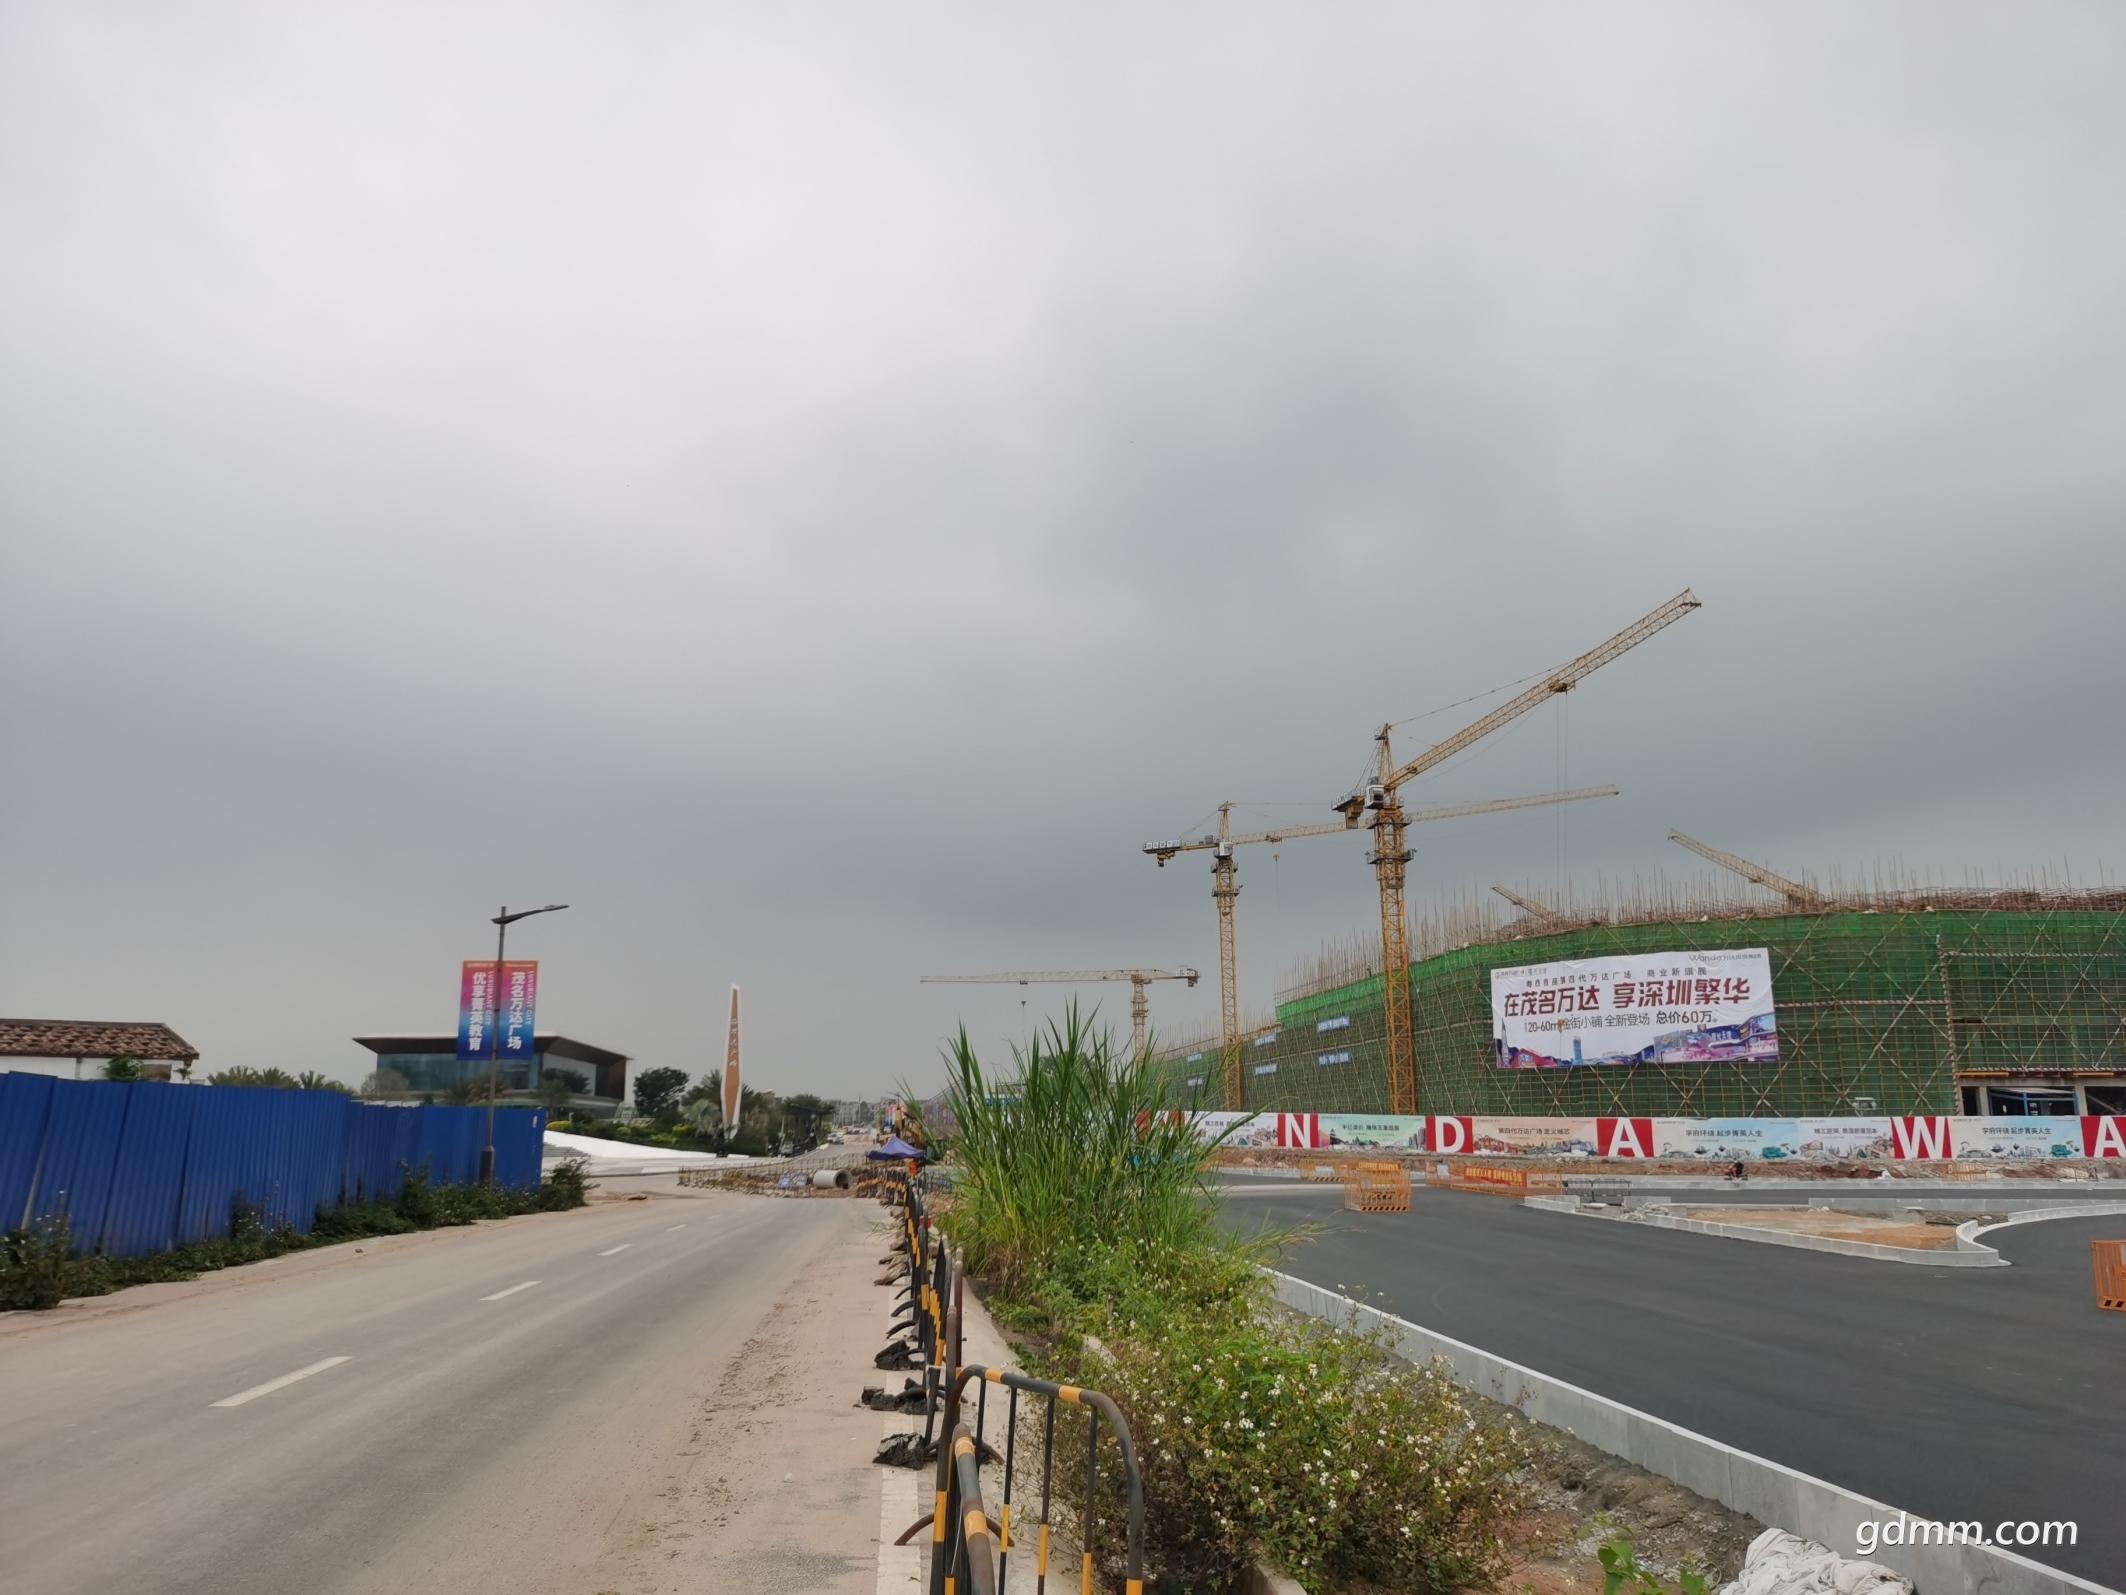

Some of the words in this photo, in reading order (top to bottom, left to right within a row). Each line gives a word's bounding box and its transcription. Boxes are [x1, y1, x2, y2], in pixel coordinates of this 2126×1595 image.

[507, 971, 526, 1050] 茂名万达广场
[1503, 985, 1600, 1018] 在茂名万达
[1612, 977, 1750, 1009] 享深圳繁华
[1604, 1012, 1650, 1028] 全新登场
[1284, 1113, 1311, 1149] N
[1435, 1116, 1466, 1153] D
[1607, 1117, 1645, 1158] A
[1892, 1116, 1946, 1159] W
[2093, 1115, 2126, 1158] A
